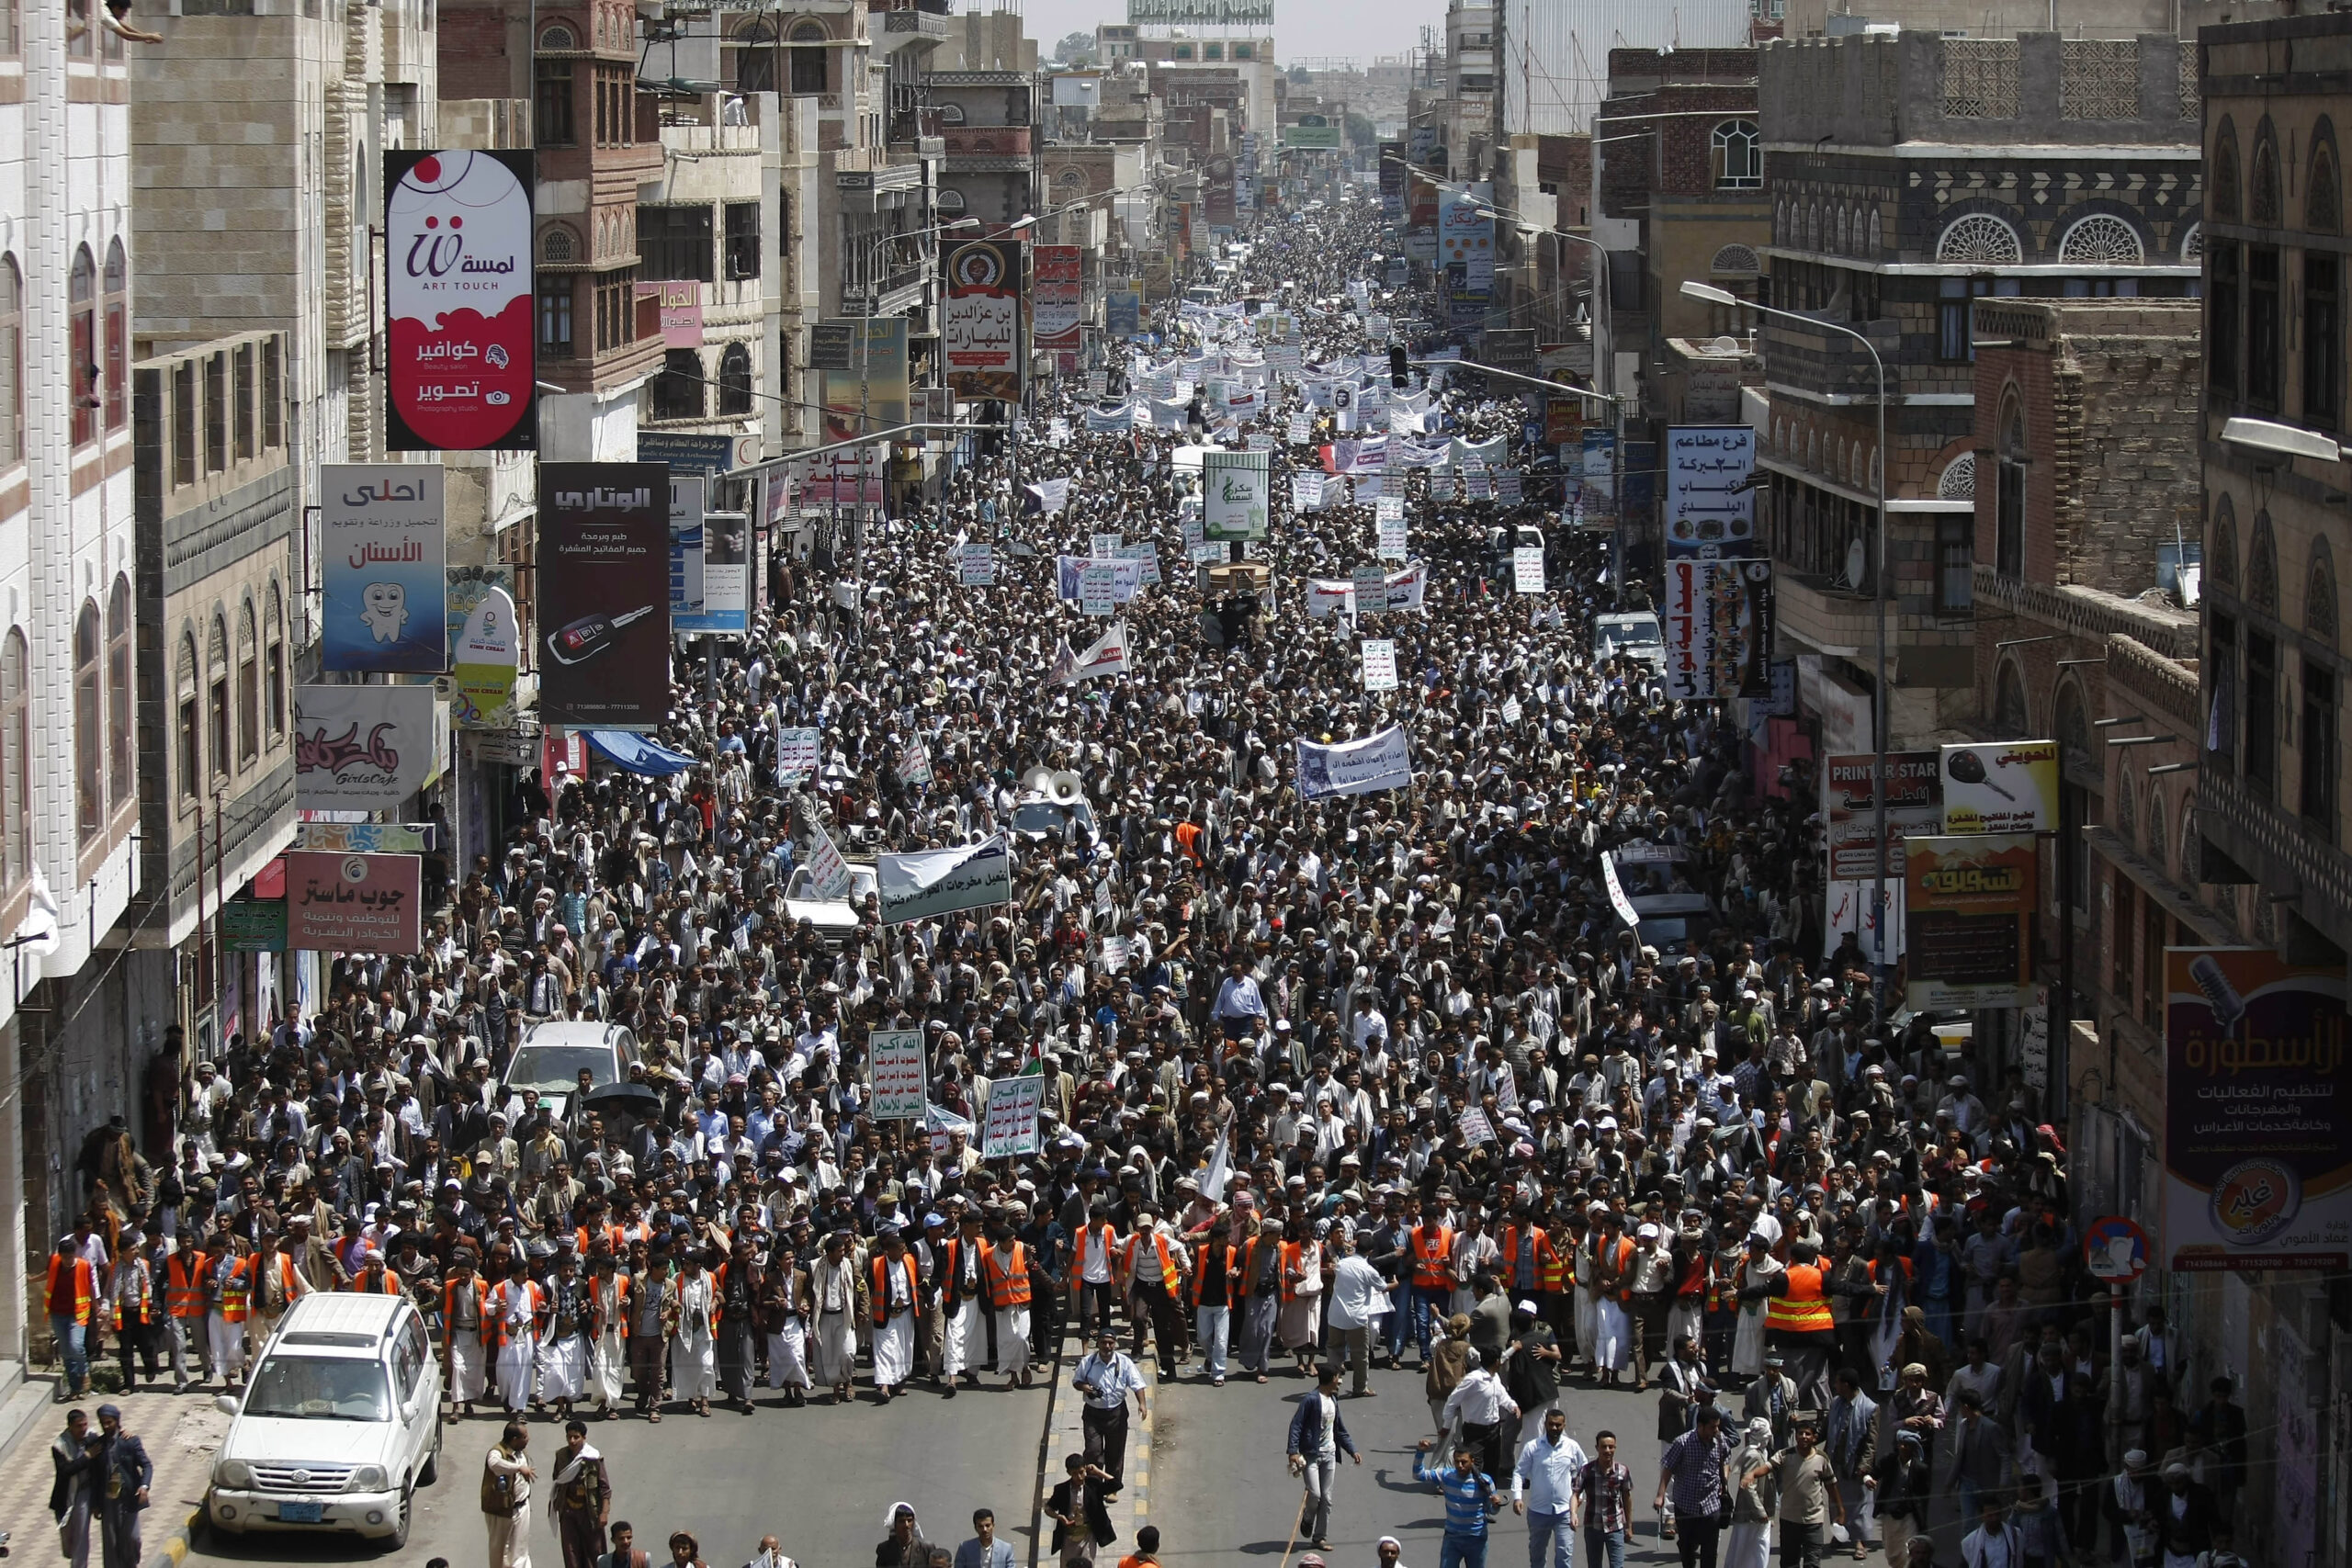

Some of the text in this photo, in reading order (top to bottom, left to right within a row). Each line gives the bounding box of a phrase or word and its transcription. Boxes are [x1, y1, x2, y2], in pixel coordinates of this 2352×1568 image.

[461, 254, 514, 274] لمسة
[647, 284, 696, 310] الخولا
[996, 308, 1011, 323] بن
[947, 327, 1011, 349] للبهارات
[416, 341, 478, 361] كوافير
[417, 381, 480, 401] تصوير
[1676, 434, 1747, 451] فرع مطاعم
[343, 479, 424, 506] احلى
[555, 487, 650, 512] الوتاري
[1678, 502, 1746, 517] البلدي
[332, 518, 437, 527] لتجميل وزراعة وتقويم
[582, 533, 627, 542] طبع وبرمجة
[348, 536, 423, 570] الأسنان
[559, 544, 647, 555] جميع المفاتيح المشفرة
[1670, 563, 1698, 697] صيدلية نوبل
[1833, 762, 1937, 781] PRINTR STAR
[1843, 786, 1929, 816] للطبعة
[947, 875, 981, 891] مخرجات
[300, 879, 405, 911] جوب ماستر
[303, 910, 400, 925] للتوظيف وتنمية
[303, 926, 400, 939] الكوادر البشرية
[875, 1033, 920, 1055] الله أكبر
[2185, 1008, 2343, 1077] الأسطورة
[900, 1055, 921, 1066] الموت
[900, 1069, 922, 1080] الموت
[1022, 1081, 1038, 1093] الله
[2198, 1083, 2334, 1101] لتنظيم الفعاليات
[903, 1096, 923, 1112] النصر
[2224, 1102, 2301, 1116] والمهرجانات
[2194, 1119, 2332, 1134] وكافة خدمات الاعراس
[2230, 1179, 2272, 1216] غير
[2279, 1233, 2348, 1247] عماد الأموي
